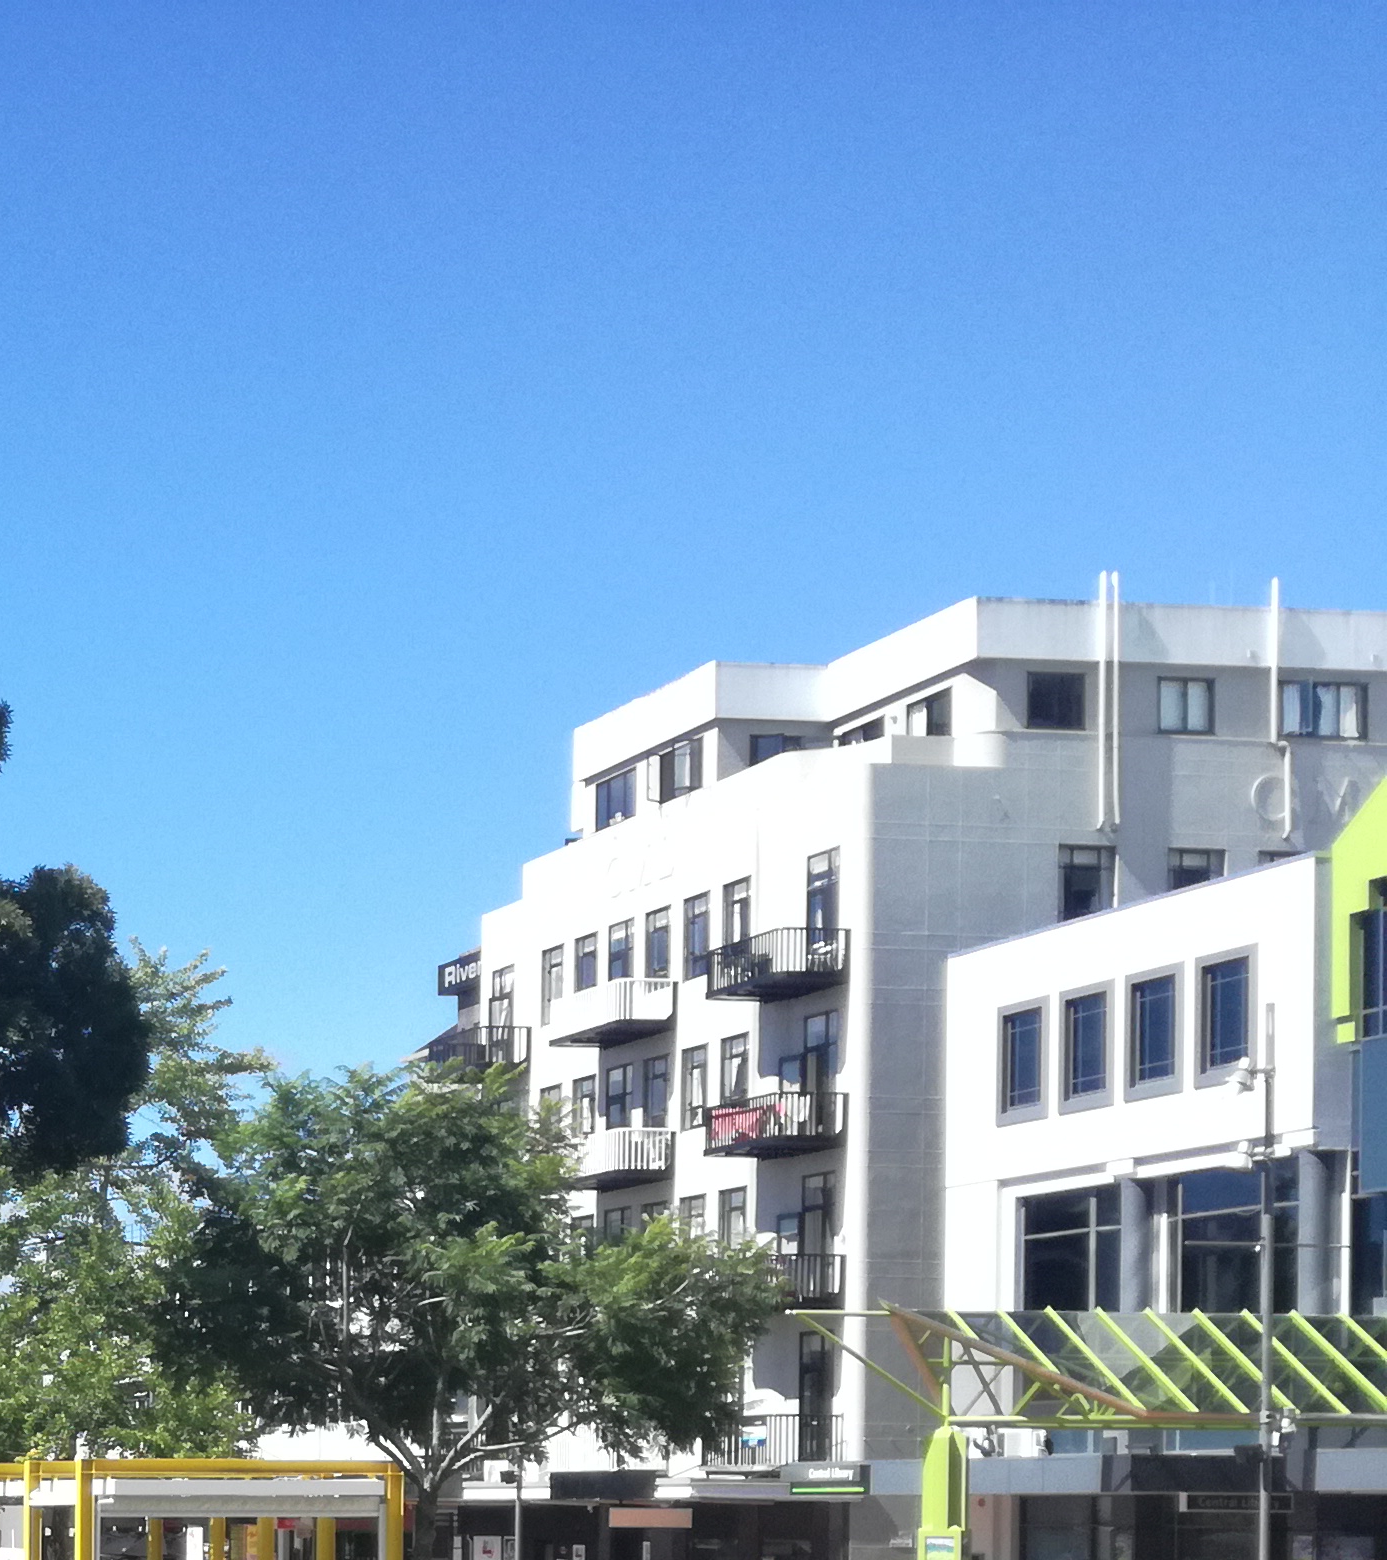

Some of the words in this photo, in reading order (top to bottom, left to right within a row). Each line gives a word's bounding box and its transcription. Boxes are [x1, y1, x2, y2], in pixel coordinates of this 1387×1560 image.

[808, 1467, 830, 1478] Central
[831, 1467, 854, 1480] Library
[1197, 1496, 1237, 1508] Central
[1241, 1496, 1279, 1510] Liby
